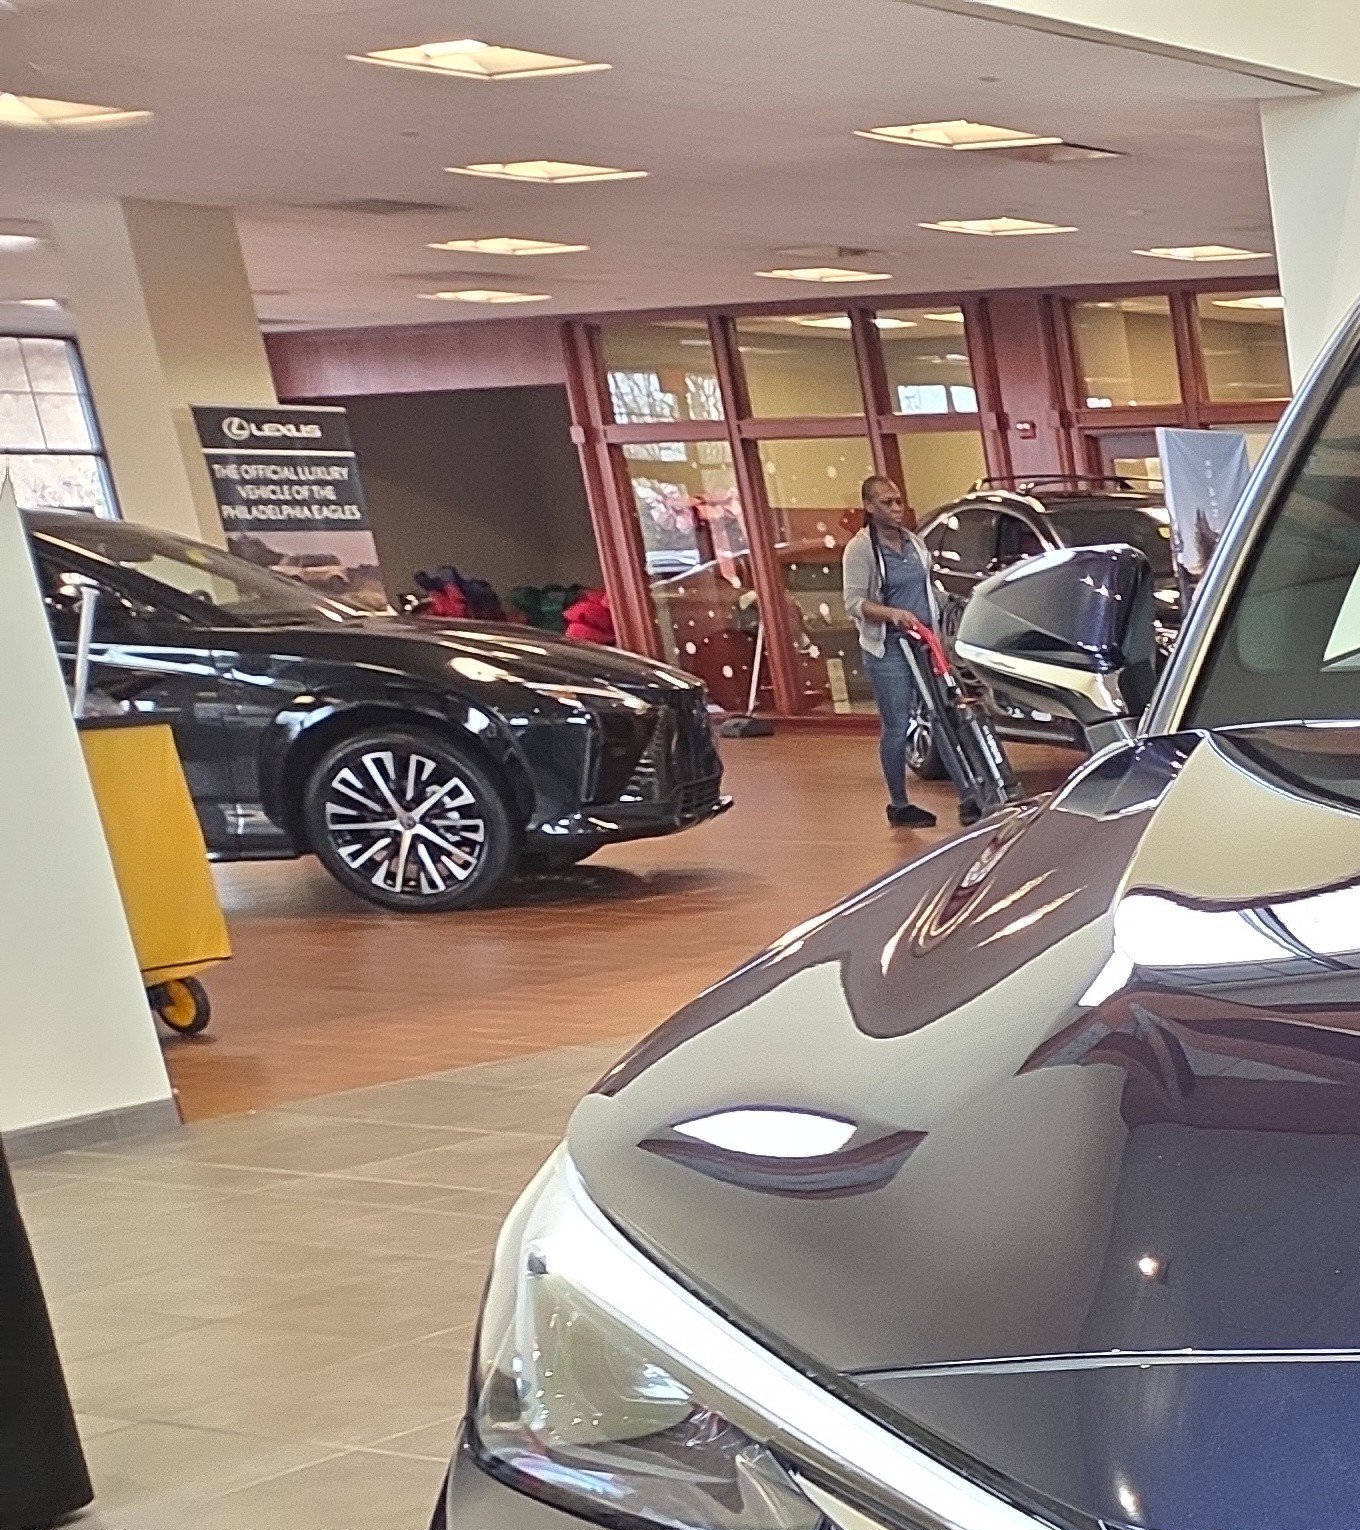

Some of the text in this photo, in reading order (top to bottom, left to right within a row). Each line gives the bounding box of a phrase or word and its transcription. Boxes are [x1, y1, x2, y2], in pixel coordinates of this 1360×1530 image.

[251, 423, 322, 438] LEXUS
[212, 464, 349, 480] THE OFFICIAL LUXURY
[236, 485, 336, 500] VEHICLE OF THE
[221, 505, 362, 520] PHILADELPHIA EAGLES
